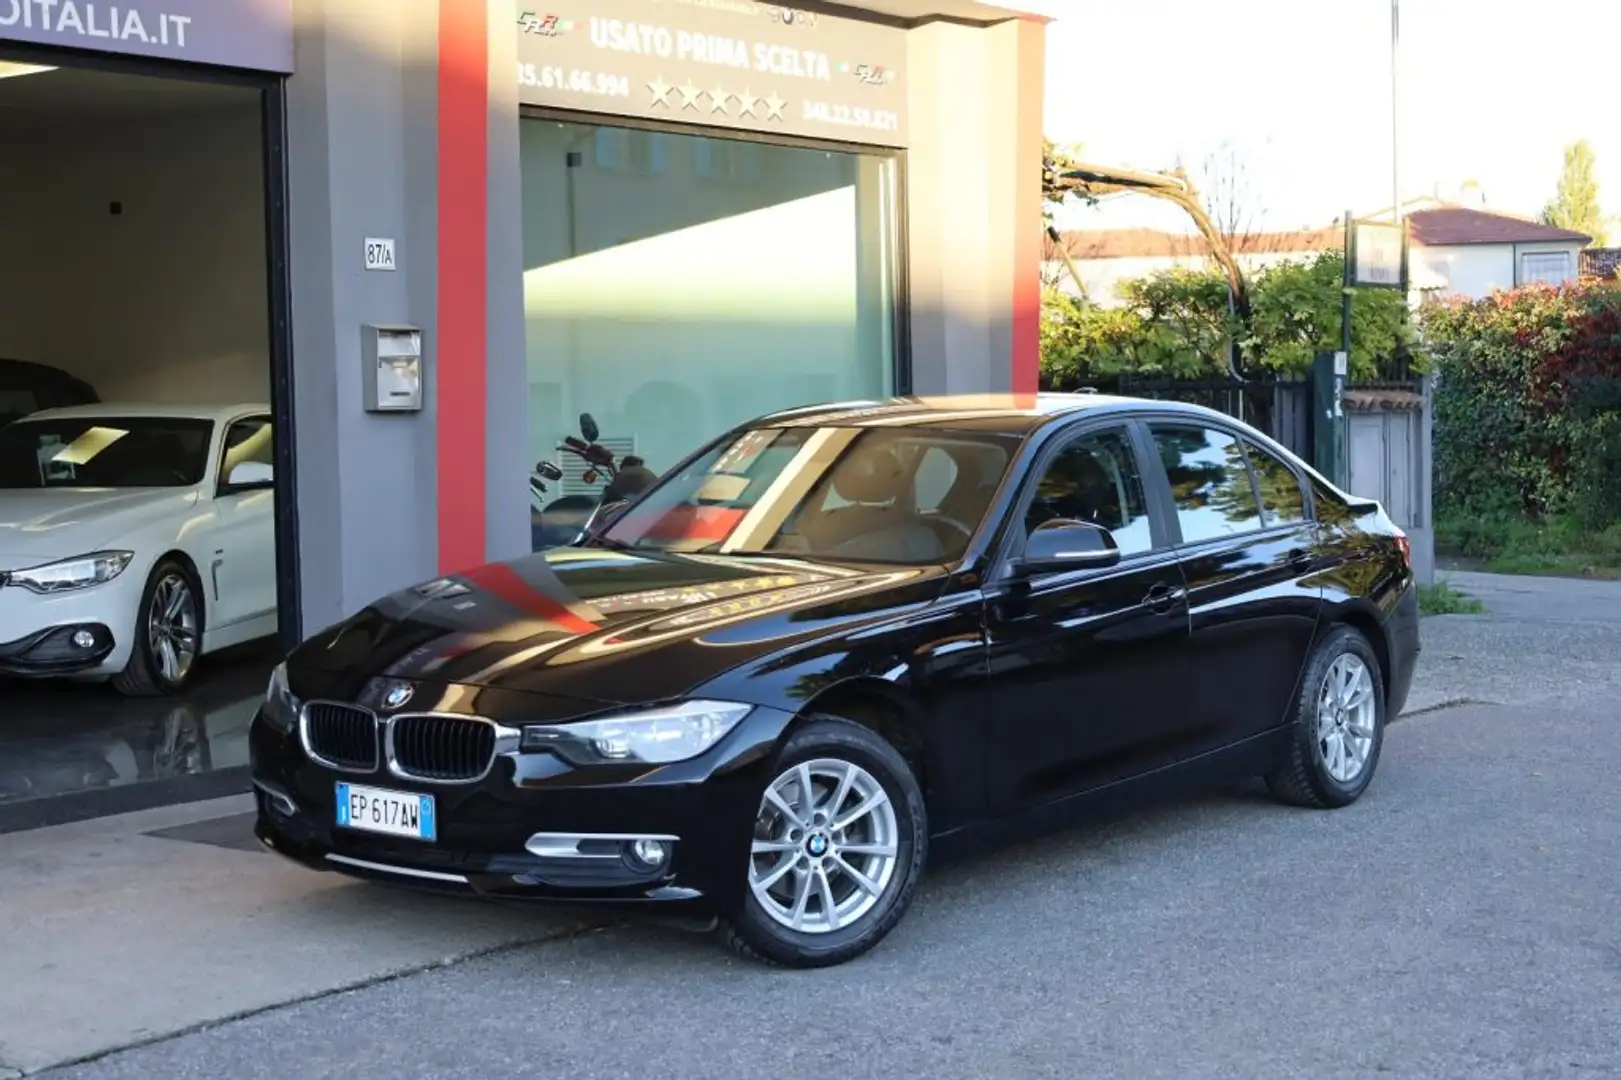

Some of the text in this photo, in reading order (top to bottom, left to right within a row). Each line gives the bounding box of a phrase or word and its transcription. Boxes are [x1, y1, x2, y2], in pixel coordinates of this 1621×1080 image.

[590, 16, 673, 58] USATO
[676, 30, 749, 69] PRIMA
[754, 42, 831, 81] SCELTA
[367, 244, 392, 264] 87/A
[350, 794, 418, 829] EP 617AW
